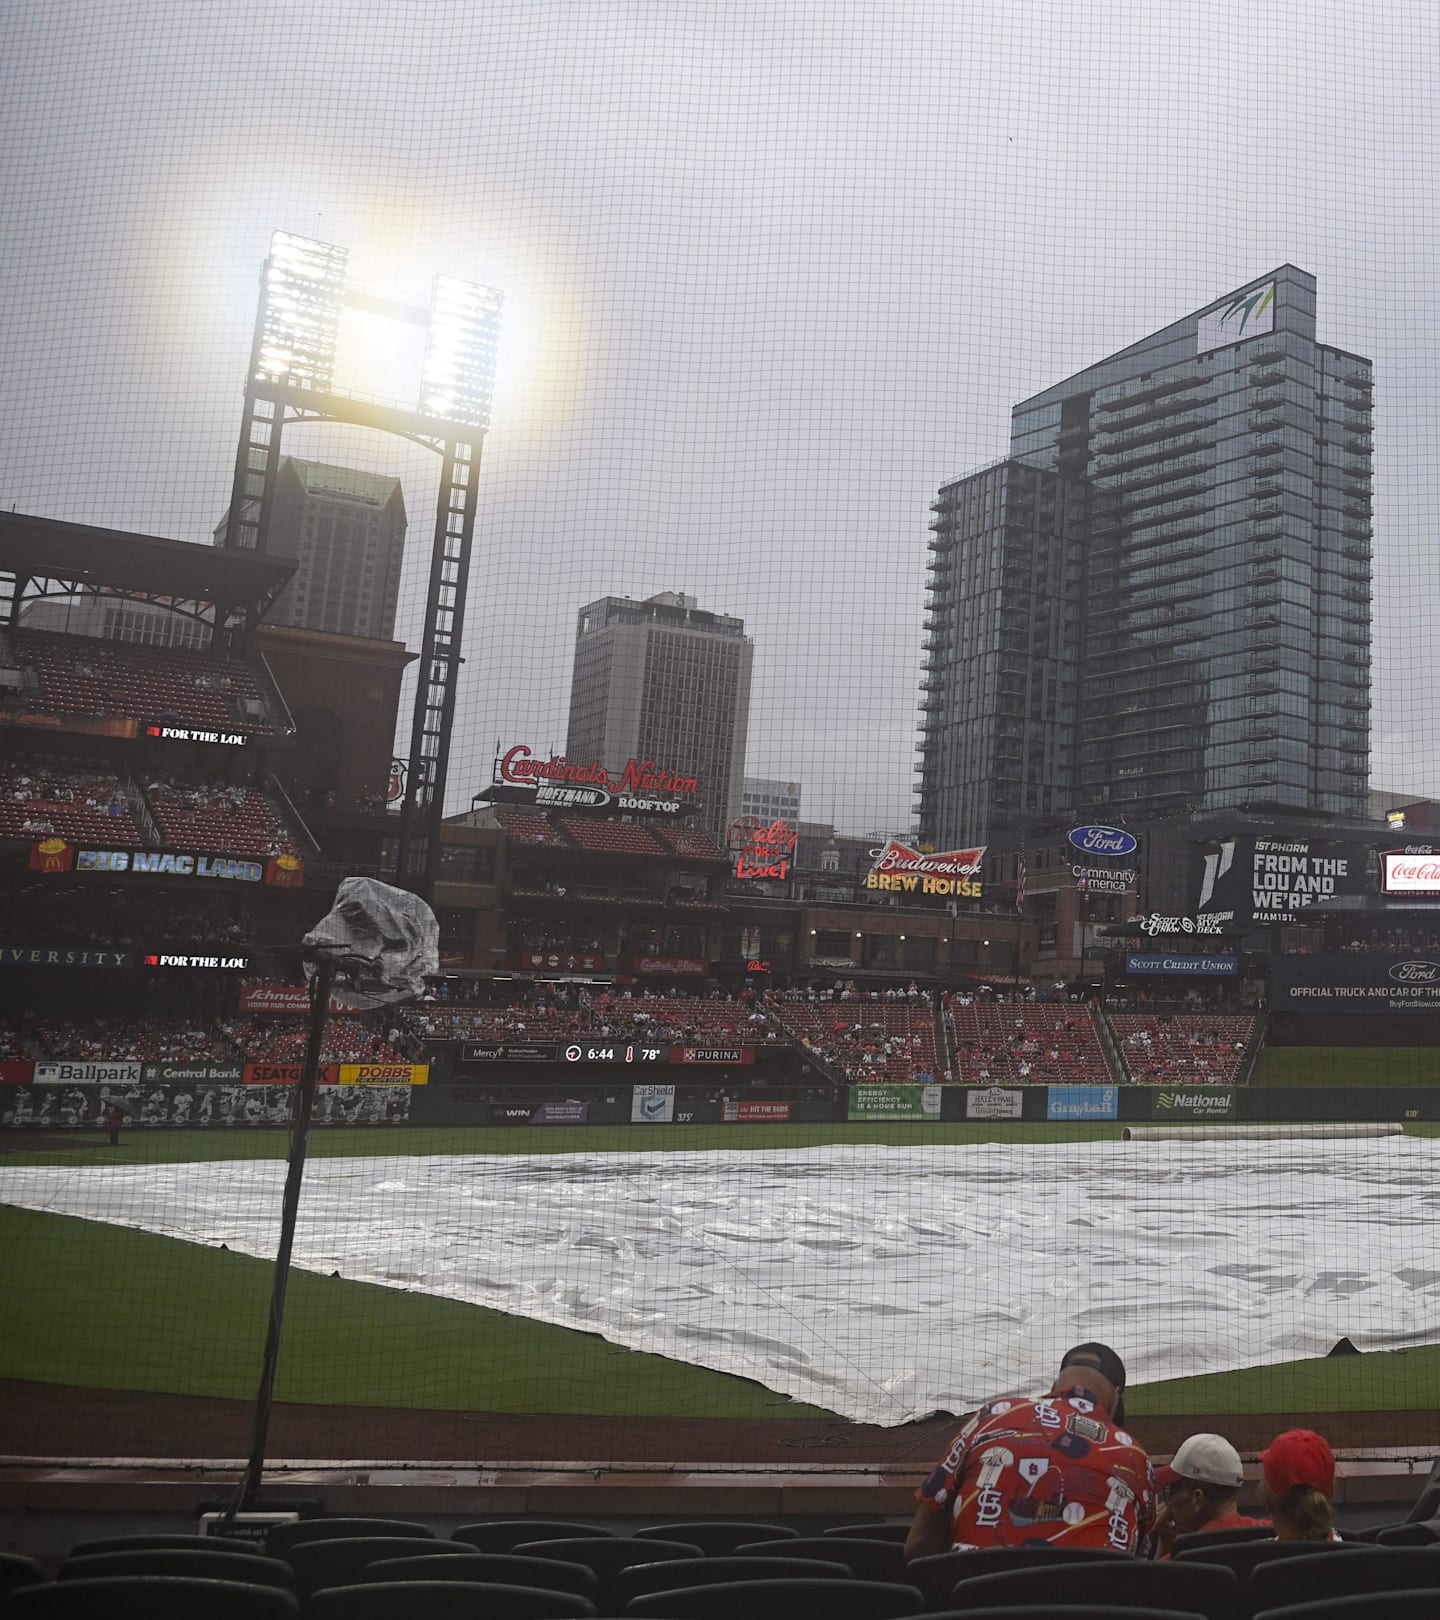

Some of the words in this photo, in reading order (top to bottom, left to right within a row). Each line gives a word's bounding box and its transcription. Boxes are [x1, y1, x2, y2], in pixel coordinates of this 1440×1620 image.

[162, 727, 189, 740] FOR
[191, 730, 218, 743] THE
[220, 733, 247, 746] LOU
[500, 745, 608, 785] Cardinals
[610, 758, 698, 795] Nation
[535, 785, 599, 804] HOFFMANN
[618, 796, 680, 813] ROOFTOP
[1083, 828, 1124, 851] Ford
[76, 850, 128, 871] BIG
[131, 852, 194, 875] MAC
[196, 856, 263, 882] LAND
[868, 848, 982, 875] Budweiser
[1253, 853, 1308, 874] FROM
[1311, 857, 1348, 876] THE
[1072, 865, 1135, 883] Community
[866, 873, 920, 893] BREW
[922, 879, 983, 898] HOUSE
[1253, 872, 1290, 891] LOU
[1294, 875, 1334, 894] AND
[1196, 926, 1224, 934] DECK
[160, 955, 189, 967] FOR
[189, 956, 219, 967] THE
[220, 957, 249, 969] LOU
[1163, 959, 1199, 970] CREDIT
[1201, 959, 1233, 970] UNION
[1399, 963, 1437, 980] Ford
[1290, 987, 1333, 997] OFFICIAL
[1333, 987, 1366, 997] TRUCK
[1367, 987, 1388, 997] AND
[1389, 987, 1410, 997] CAR
[1410, 987, 1424, 997] OF
[473, 1049, 499, 1060] Mercy
[587, 1048, 614, 1060] 6:44
[697, 1051, 739, 1060] PURINA
[59, 1064, 139, 1083] Ballpark
[163, 1067, 206, 1079] Central
[209, 1067, 241, 1079] Bank
[357, 1066, 413, 1078] DOBBS
[634, 1085, 674, 1096] CarShield
[1174, 1093, 1231, 1108] National
[506, 1109, 530, 1117] WIN
